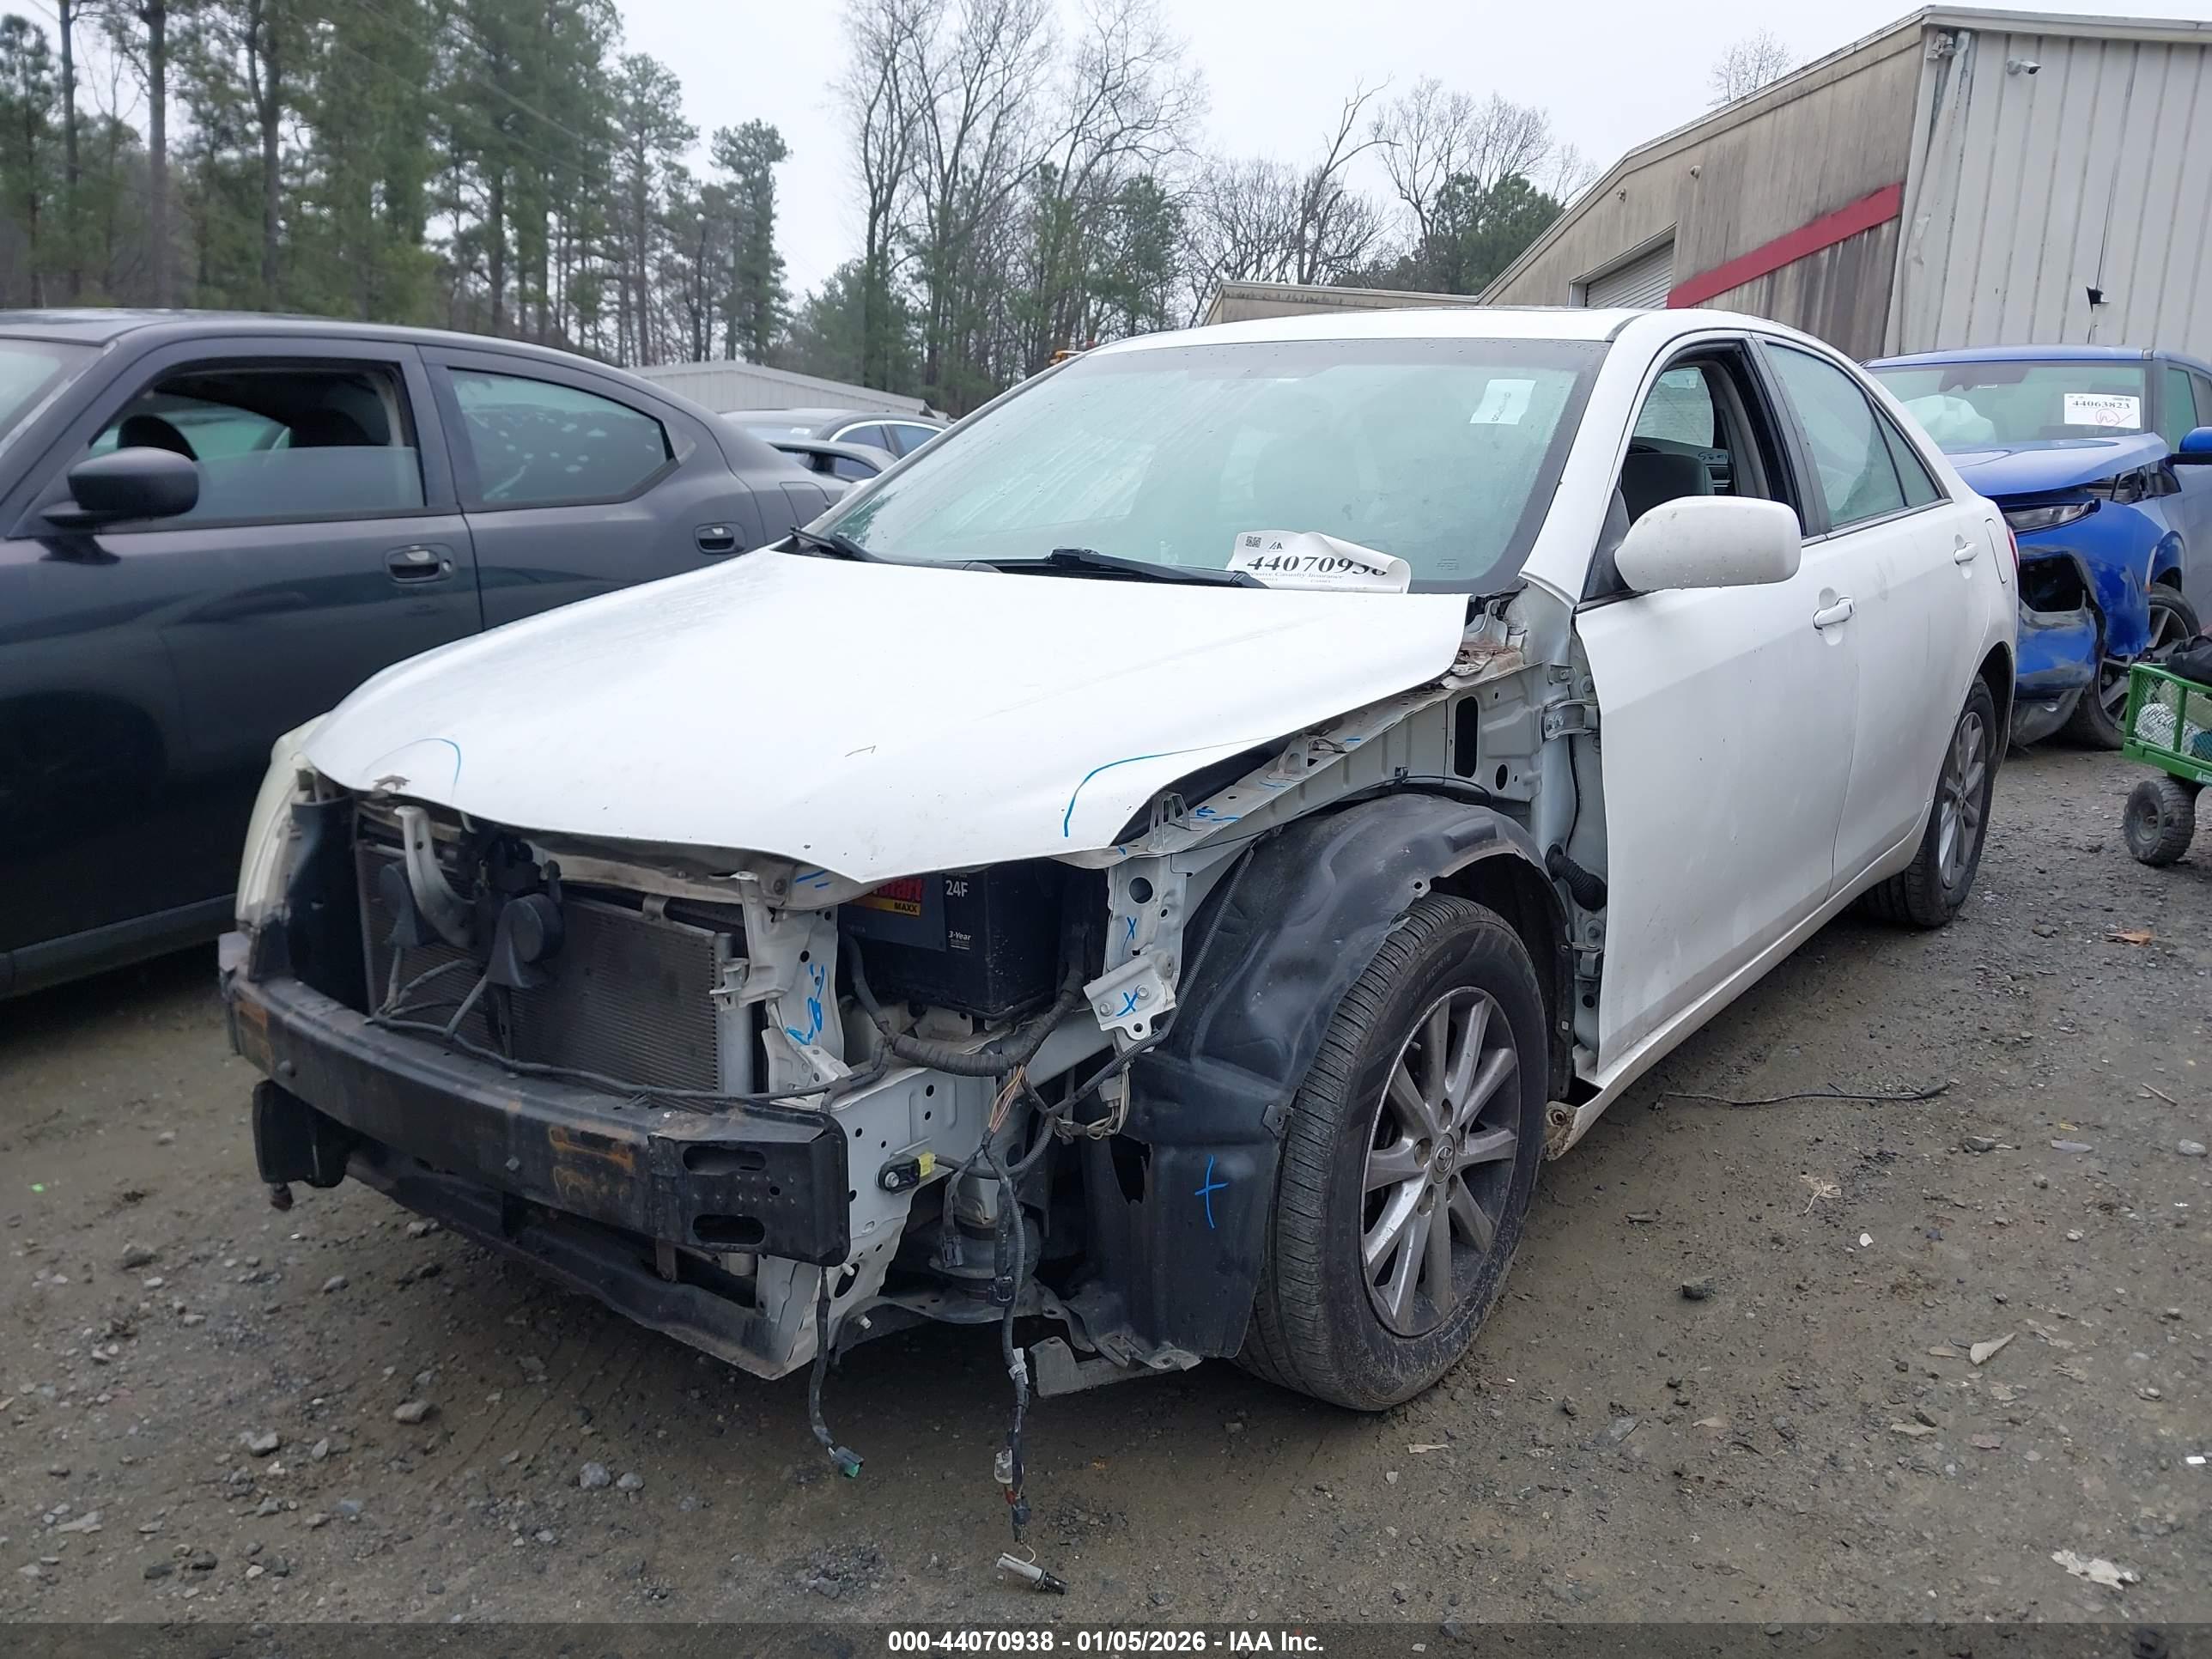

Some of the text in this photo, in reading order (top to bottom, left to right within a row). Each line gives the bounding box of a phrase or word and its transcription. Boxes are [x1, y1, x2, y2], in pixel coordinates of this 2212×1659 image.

[2072, 400, 2130, 410] 44063823
[945, 879, 969, 898] 24F
[894, 902, 918, 913] MAXX
[947, 930, 971, 941] 3-Year
